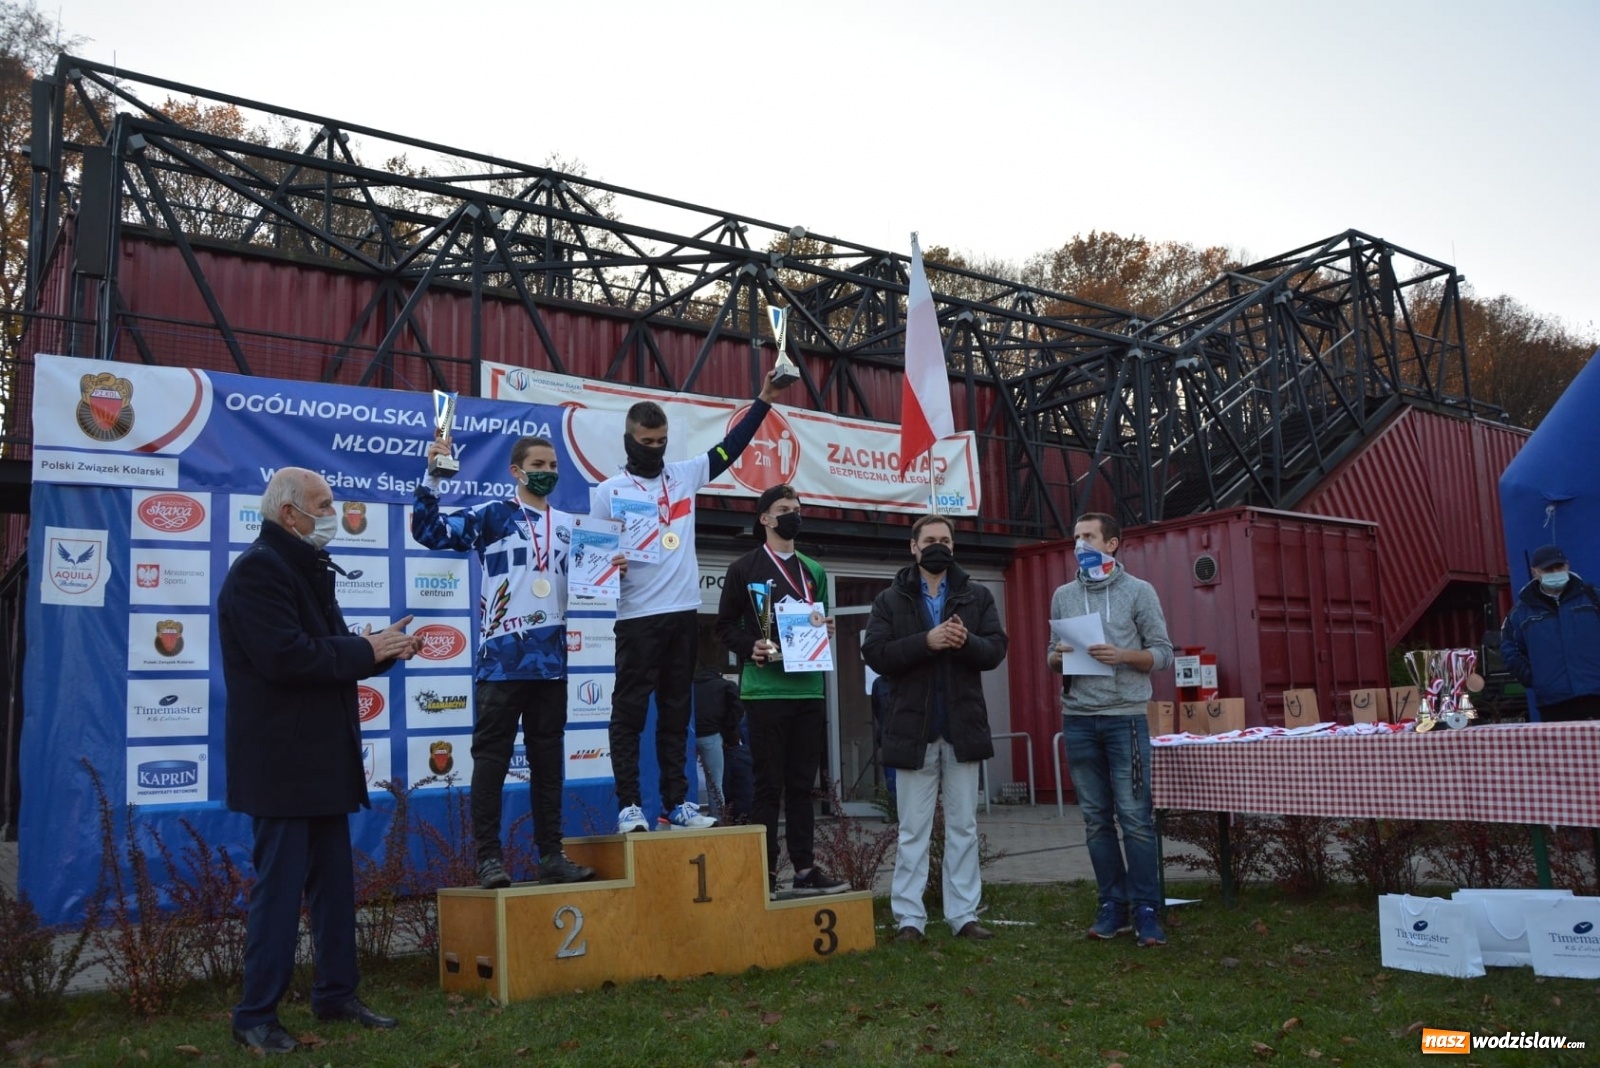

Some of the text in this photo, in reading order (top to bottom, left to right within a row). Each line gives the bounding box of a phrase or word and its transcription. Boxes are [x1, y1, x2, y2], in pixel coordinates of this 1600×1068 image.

[225, 392, 552, 439] OGÓLNOPOLSKA LIMPIADA
[332, 433, 467, 460] MŁODZIEY
[754, 450, 771, 467] 2m
[41, 460, 165, 477] Polski Związek Kolarski
[829, 465, 945, 487] BEZPIECZNĄ OLEGŁŚĆ!
[260, 466, 373, 490] Wisław
[377, 471, 420, 496] Śląs
[938, 506, 961, 514] entrum
[55, 571, 93, 580] AQUILA
[415, 575, 460, 589] mosir
[335, 580, 384, 589] memaster
[424, 631, 455, 648] kawa
[133, 705, 203, 715] Timemaster
[140, 769, 196, 786] KAPRIN
[689, 853, 713, 903] 1
[553, 904, 587, 959] 2
[813, 908, 838, 956] 3
[1548, 932, 1600, 944] Timema
